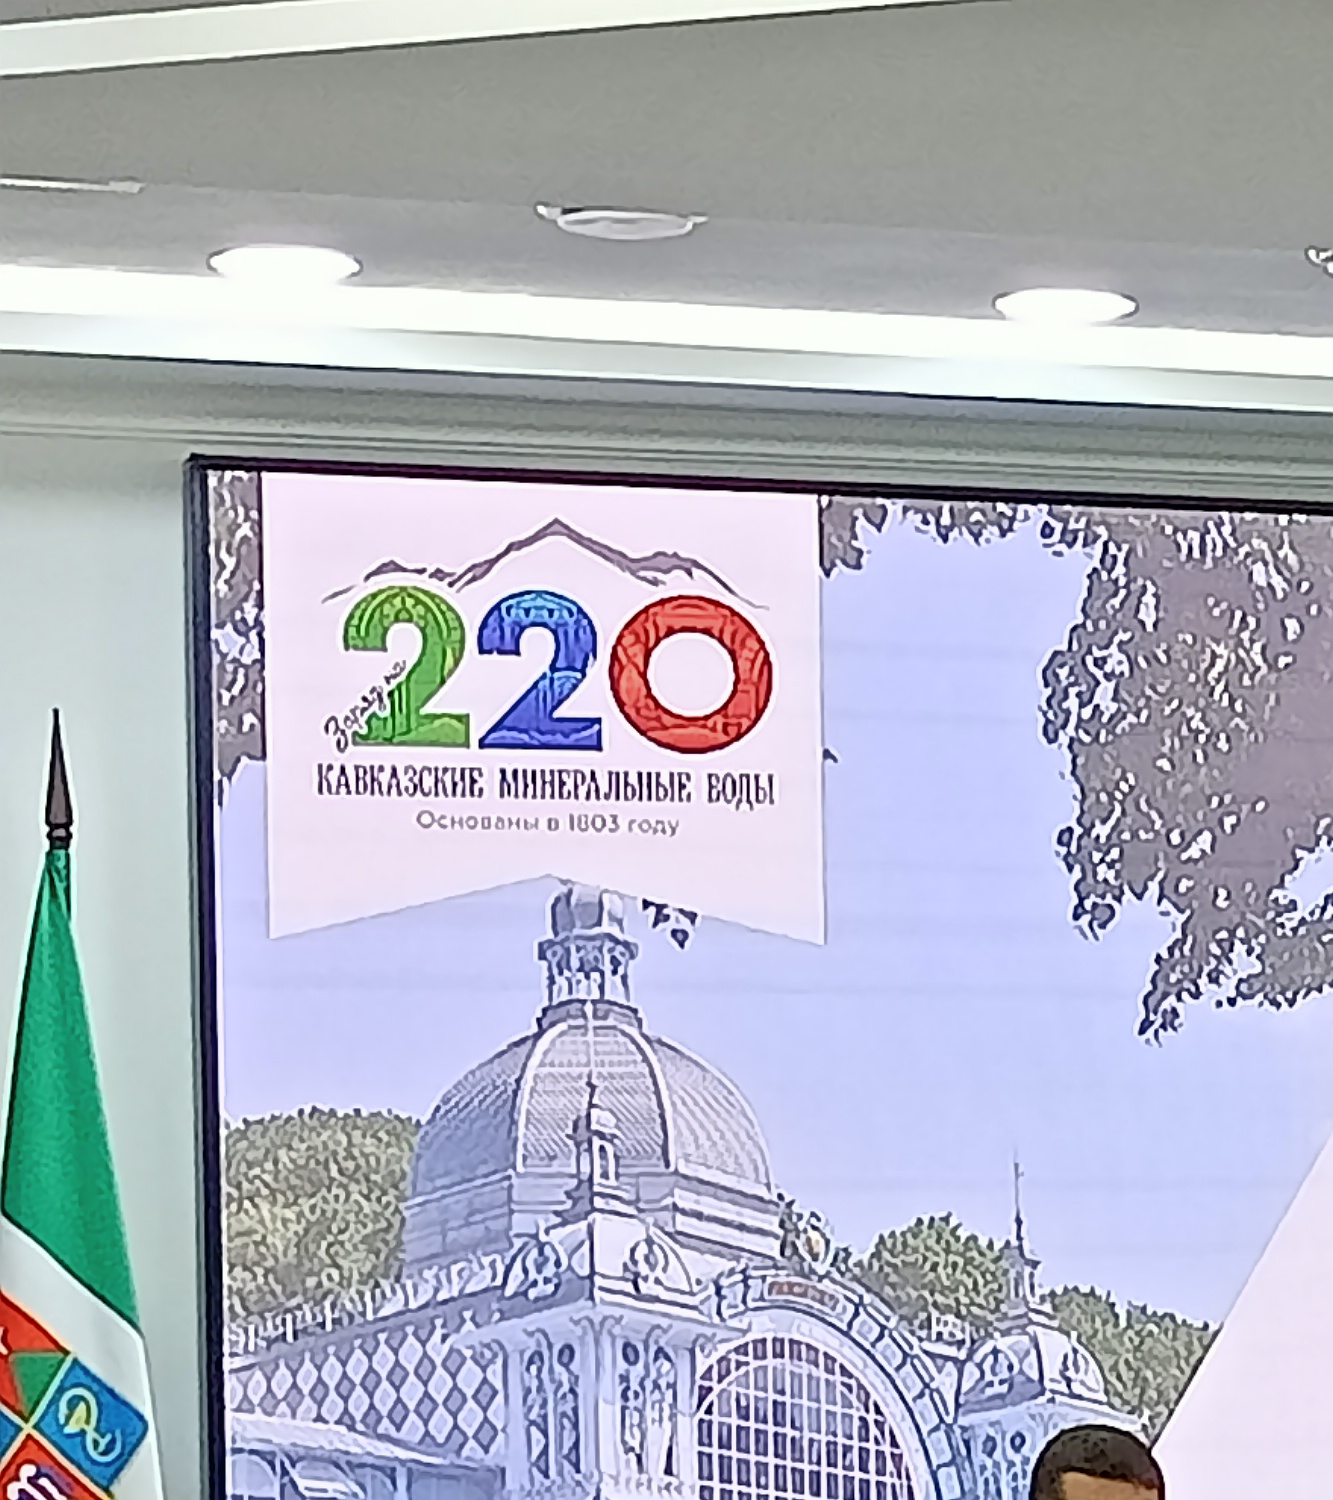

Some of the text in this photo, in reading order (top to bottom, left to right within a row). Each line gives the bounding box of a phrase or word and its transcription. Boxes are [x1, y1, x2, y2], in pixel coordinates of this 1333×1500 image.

[343, 585, 774, 754] 220
[316, 763, 775, 811] КАВКАЗСКИЕ МИНЕРАЛЬНЫЕ ВОДЫ
[416, 810, 681, 838] Основаны в 1803 году
